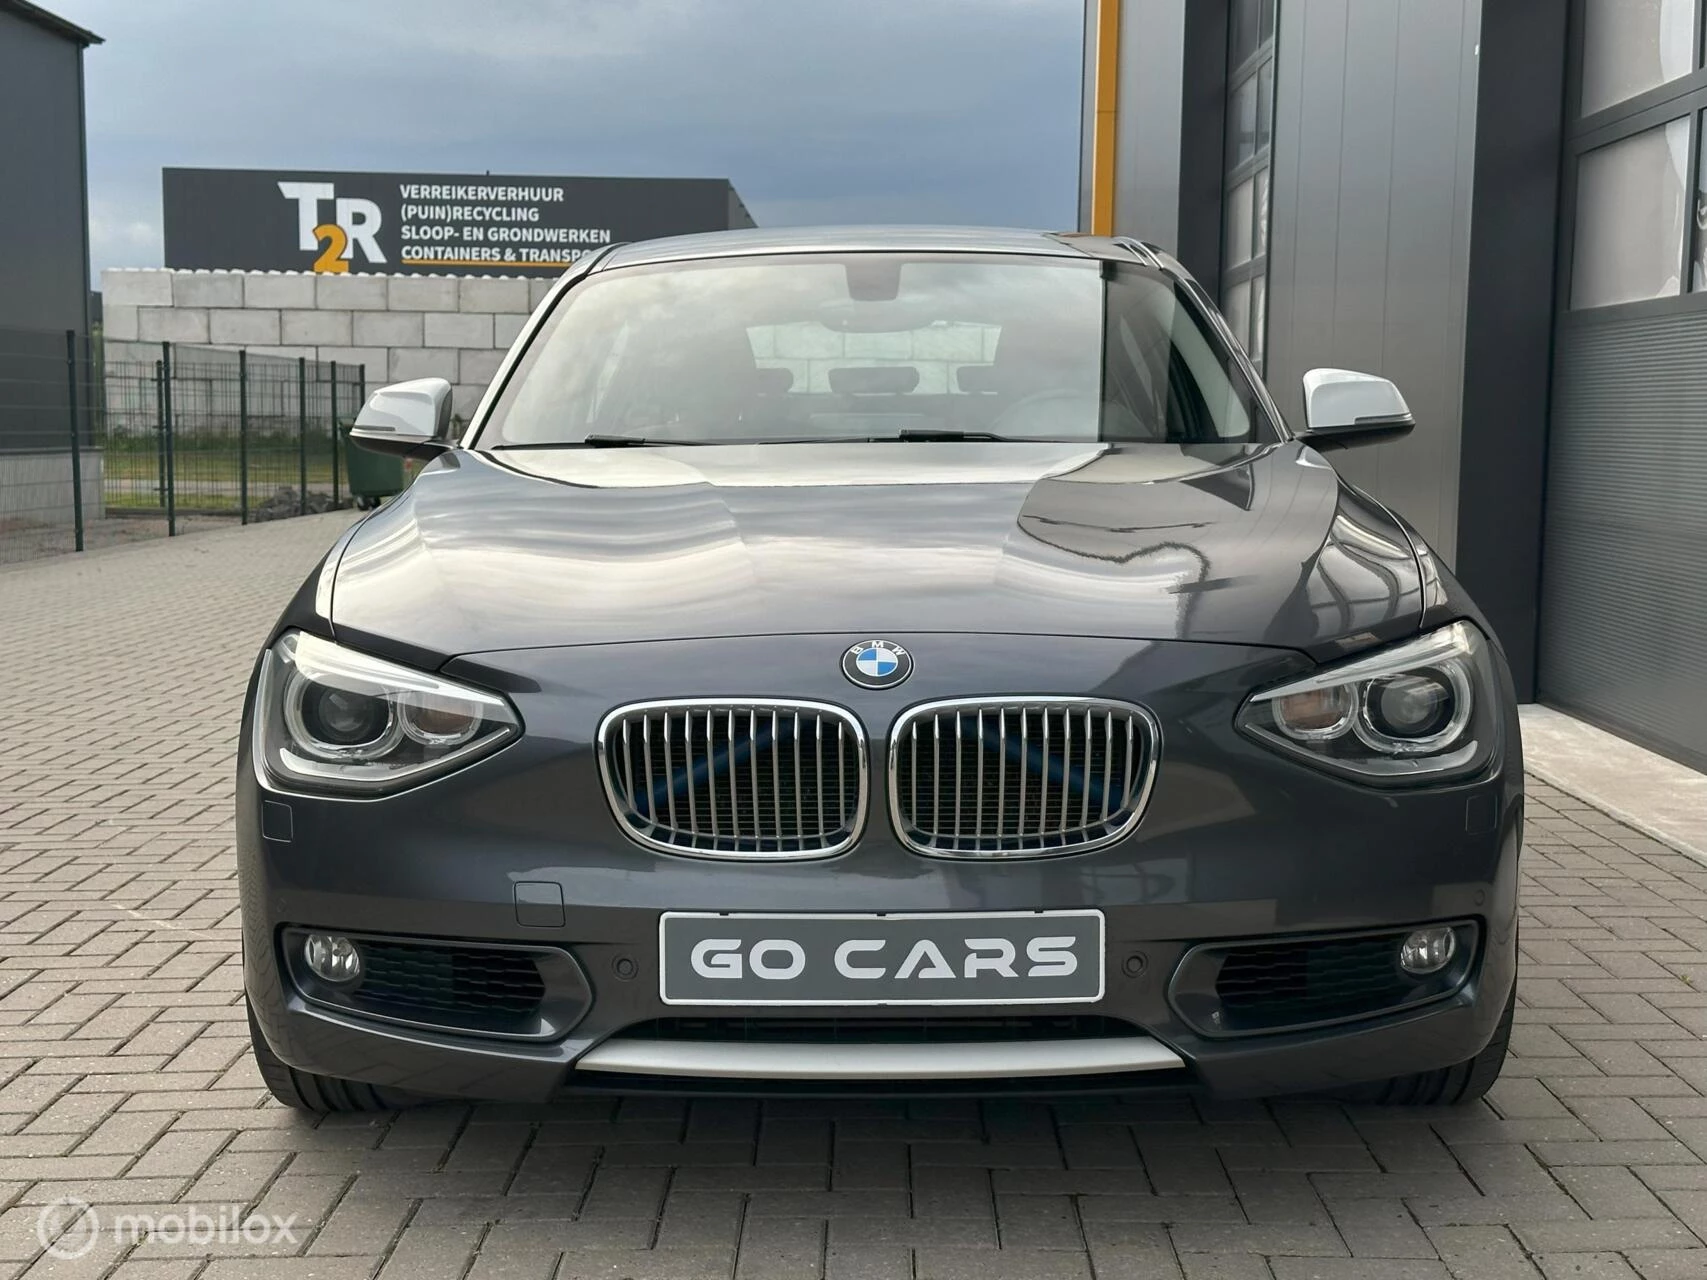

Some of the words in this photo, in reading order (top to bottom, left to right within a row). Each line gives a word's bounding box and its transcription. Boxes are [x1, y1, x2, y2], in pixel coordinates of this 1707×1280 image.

[400, 184, 564, 201] VERREIKERVERHUUR
[401, 204, 540, 222] (PUIN)RECYCLING
[401, 225, 460, 241] SLOOP-
[463, 227, 484, 241] EN
[487, 227, 611, 243] GRONDWERKEN
[401, 245, 501, 261] CONTAINERS
[503, 247, 516, 262] &
[850, 640, 906, 655] BMW
[690, 938, 806, 980] GO
[834, 936, 1078, 979] CARS
